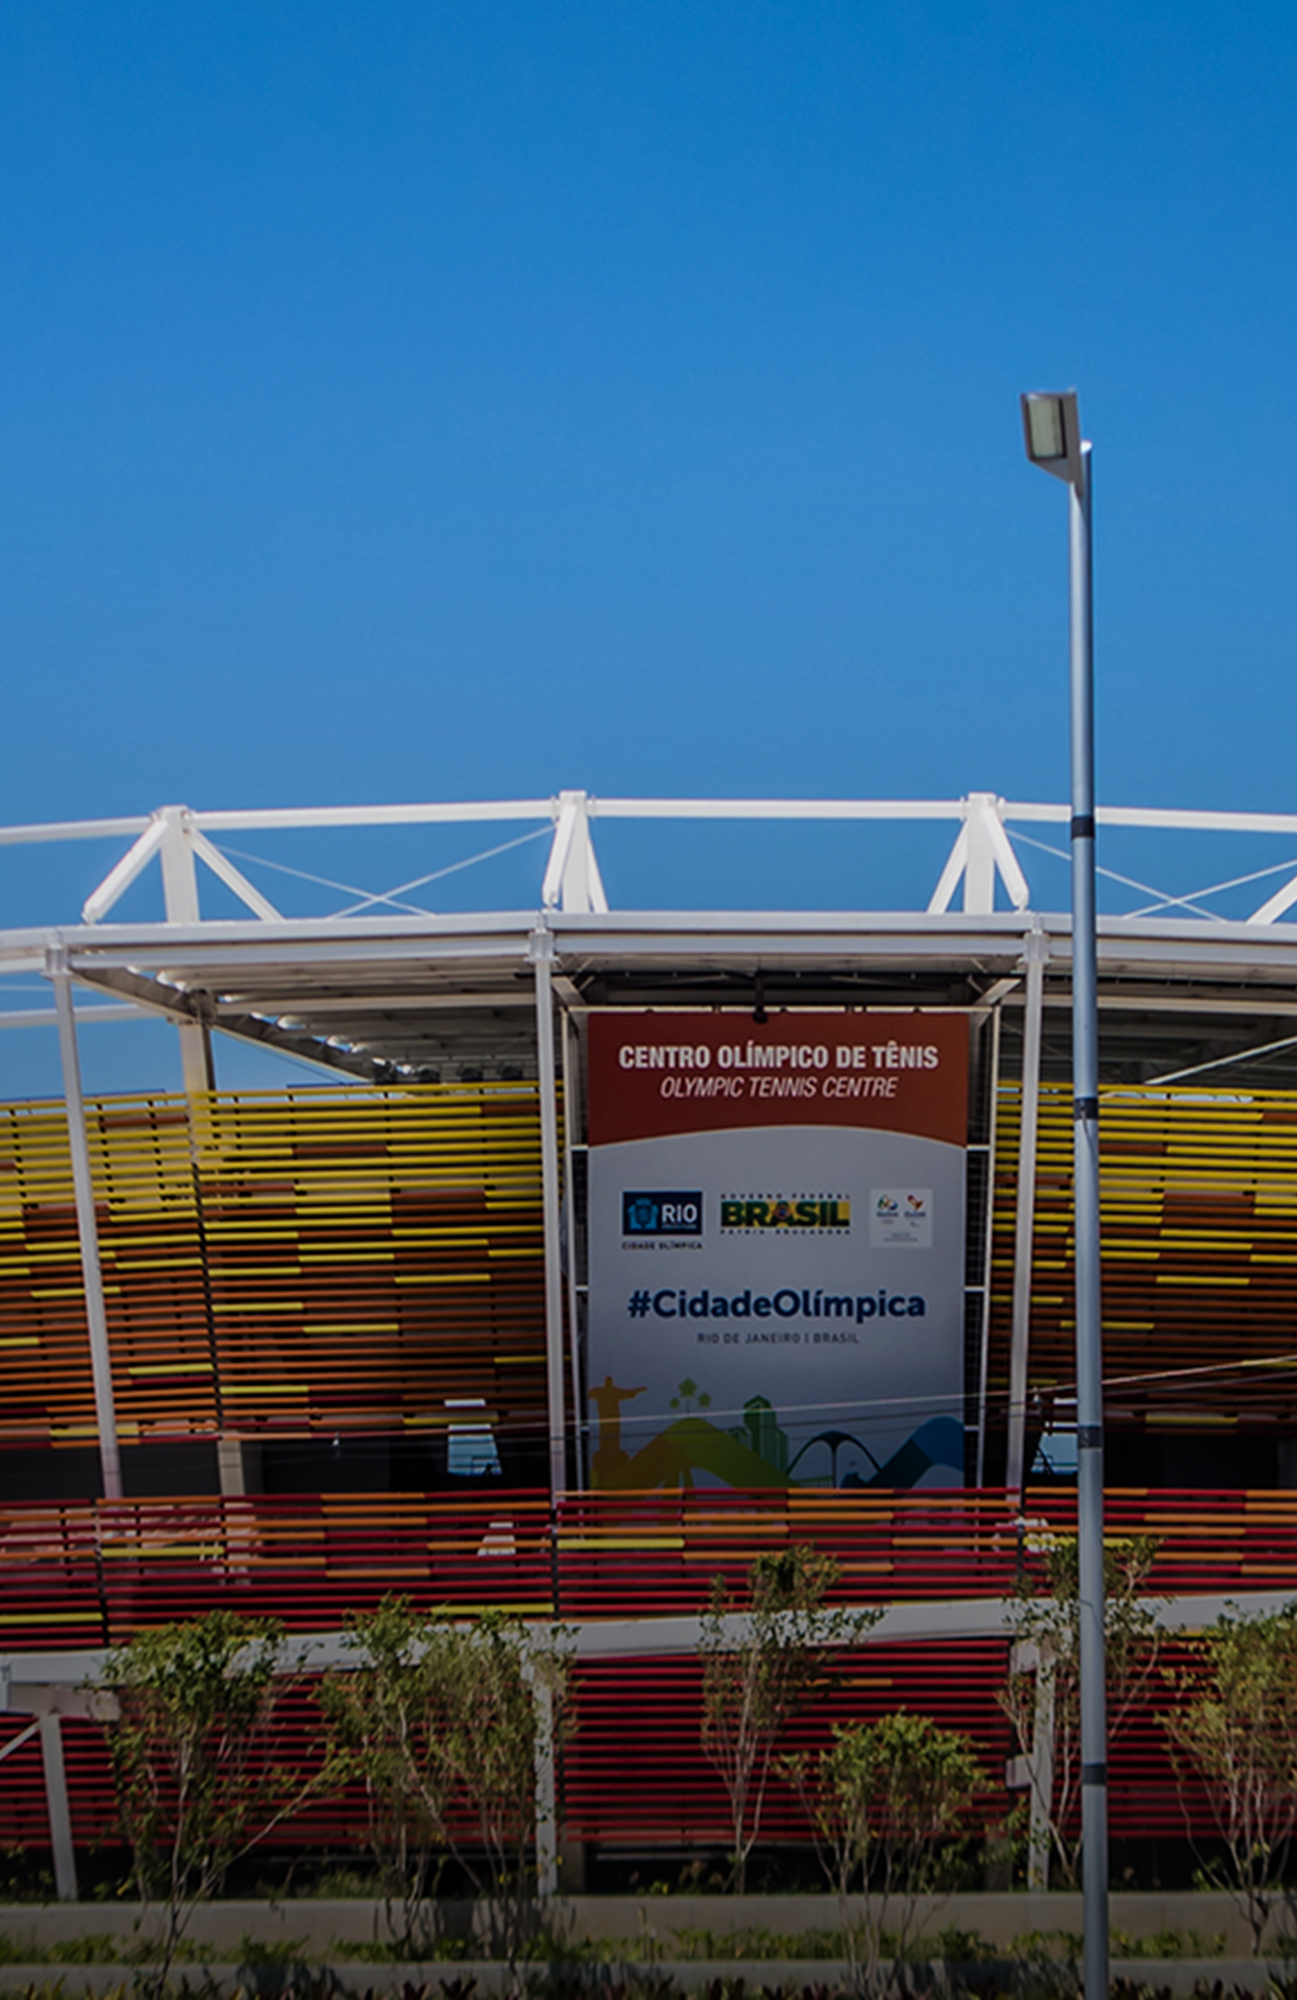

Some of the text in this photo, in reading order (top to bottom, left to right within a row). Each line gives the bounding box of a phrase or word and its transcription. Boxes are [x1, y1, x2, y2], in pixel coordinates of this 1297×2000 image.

[618, 1040, 939, 1069] CENTRO OLÍMPICO DE TÊNIS
[660, 1076, 898, 1098] OLYMPIC TENNIS CENTRE
[661, 1203, 698, 1223] RIO
[721, 1201, 850, 1227] BRASIL
[627, 1289, 926, 1324] #CidadeOlímpica
[697, 1333, 860, 1344] RIO DE JANEIRO BRASIL
